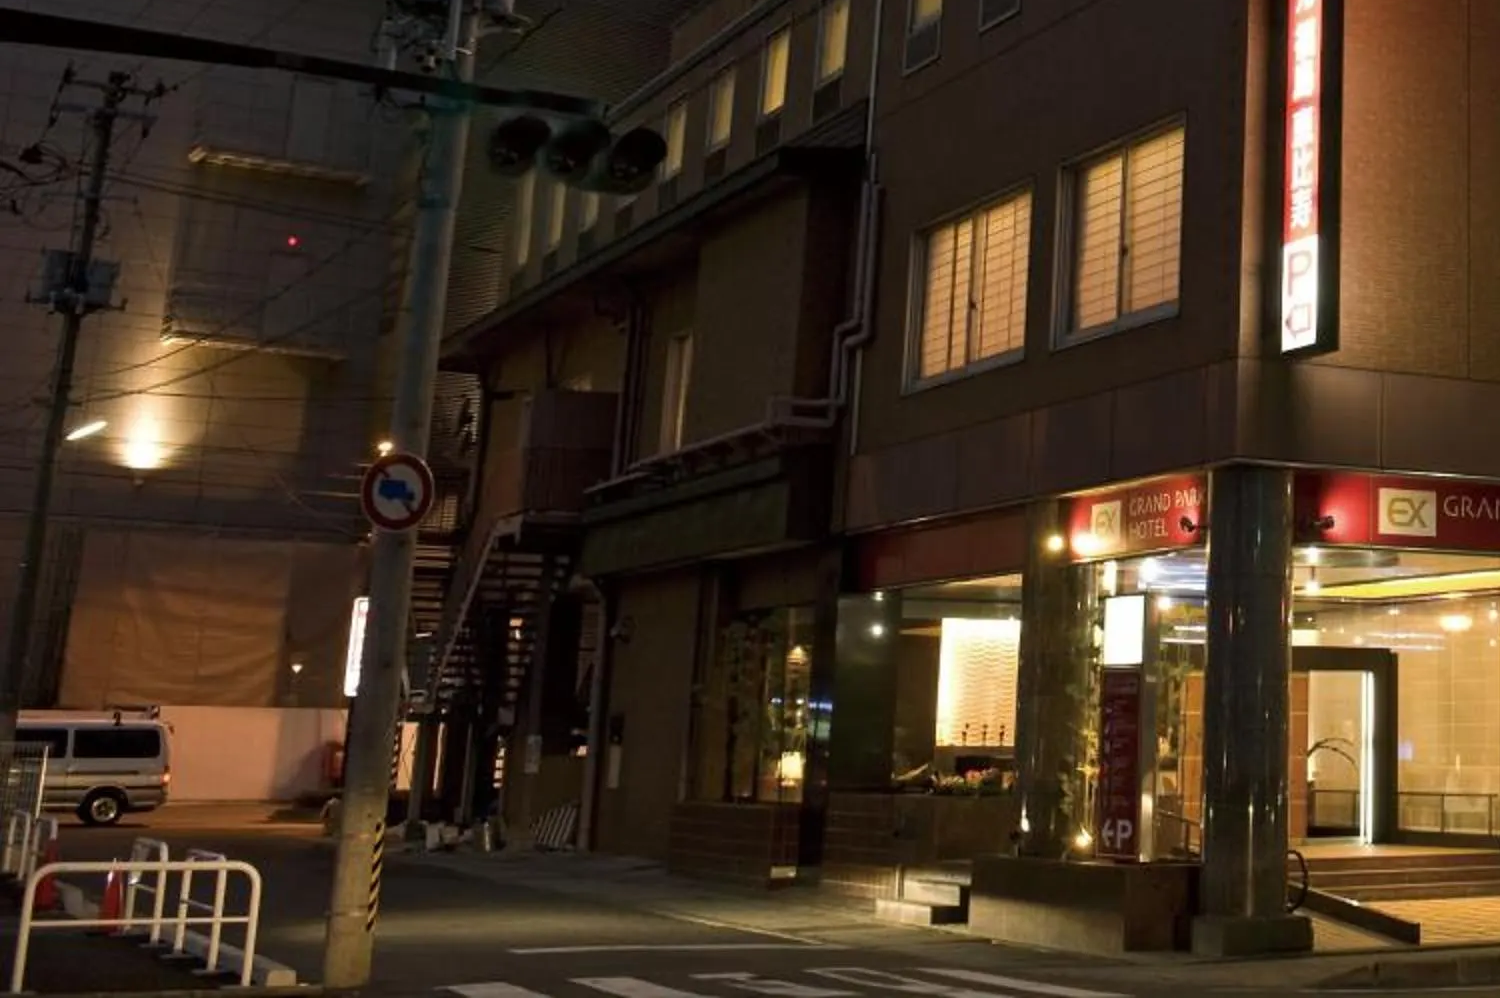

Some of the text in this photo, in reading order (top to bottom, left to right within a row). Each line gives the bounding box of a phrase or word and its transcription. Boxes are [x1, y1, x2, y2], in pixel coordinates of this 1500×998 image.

[1287, 250, 1312, 298] P
[1129, 517, 1169, 540] HOTEL
[1117, 819, 1133, 849] P
